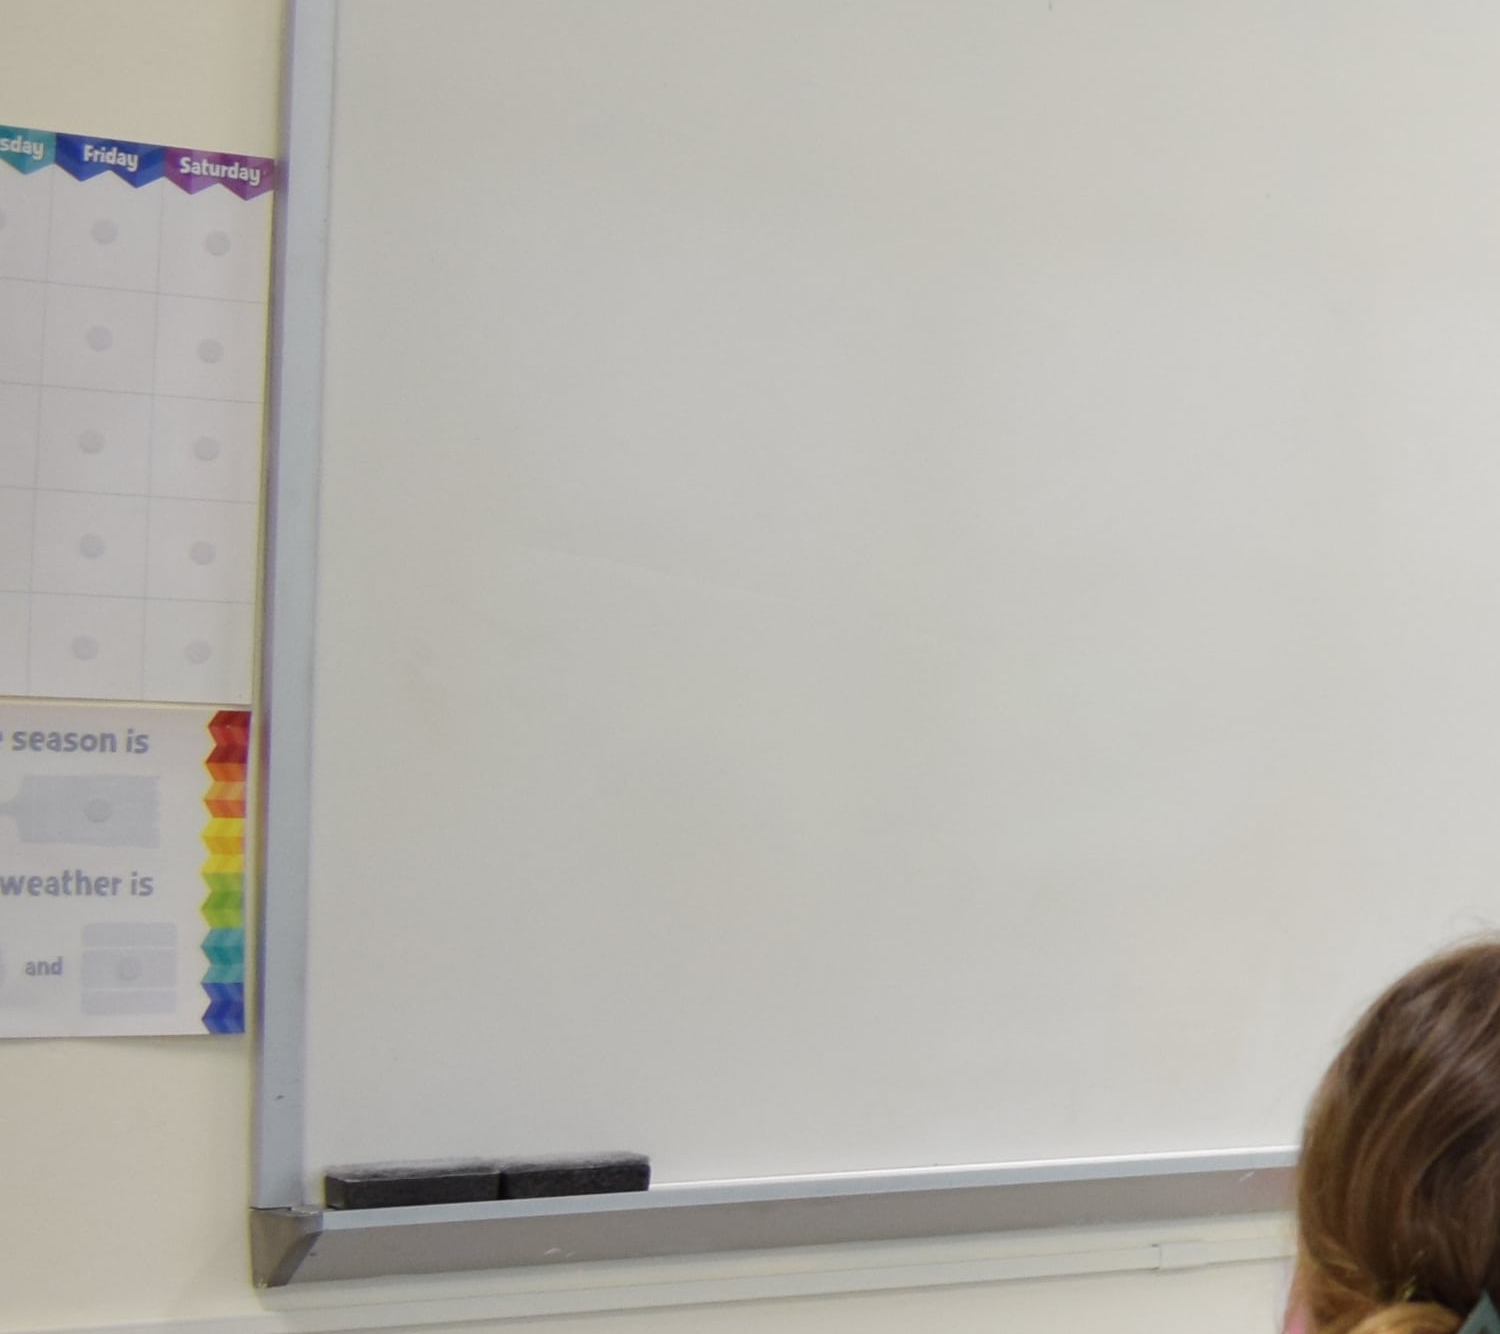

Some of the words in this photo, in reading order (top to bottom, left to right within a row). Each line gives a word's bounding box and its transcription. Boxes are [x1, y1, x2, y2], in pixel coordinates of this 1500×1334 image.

[83, 144, 139, 172] Friday
[180, 156, 261, 186] Saturday
[11, 730, 117, 753] season
[125, 729, 149, 754] is
[0, 870, 122, 896] weather
[130, 872, 154, 896] is
[25, 957, 63, 977] and
